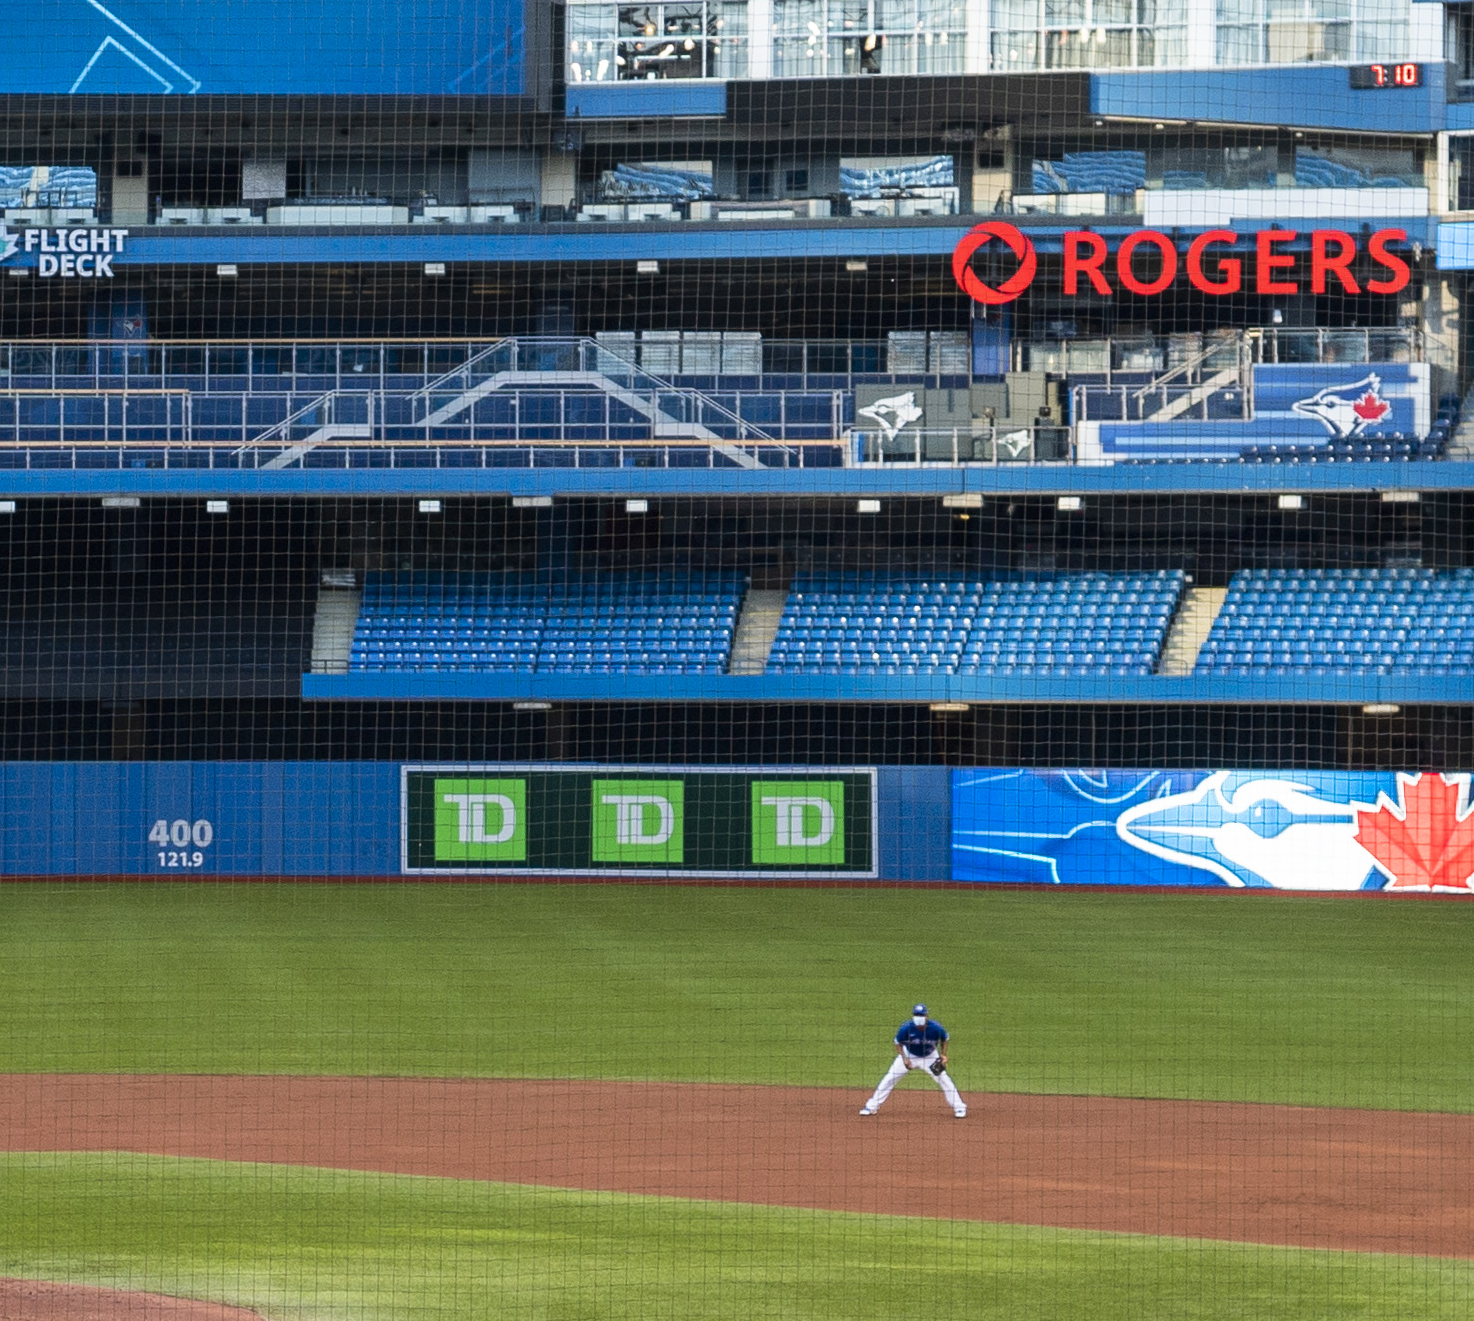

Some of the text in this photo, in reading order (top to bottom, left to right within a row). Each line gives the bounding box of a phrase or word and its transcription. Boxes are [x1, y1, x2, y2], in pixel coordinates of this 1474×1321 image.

[1371, 65, 1417, 86] 7:10
[24, 228, 129, 253] FLIGHT
[38, 253, 115, 278] DECK
[1062, 228, 1412, 296] ROGERS
[148, 818, 213, 848] 400
[443, 793, 835, 849] TD TD TD
[156, 850, 204, 869] 121.9
